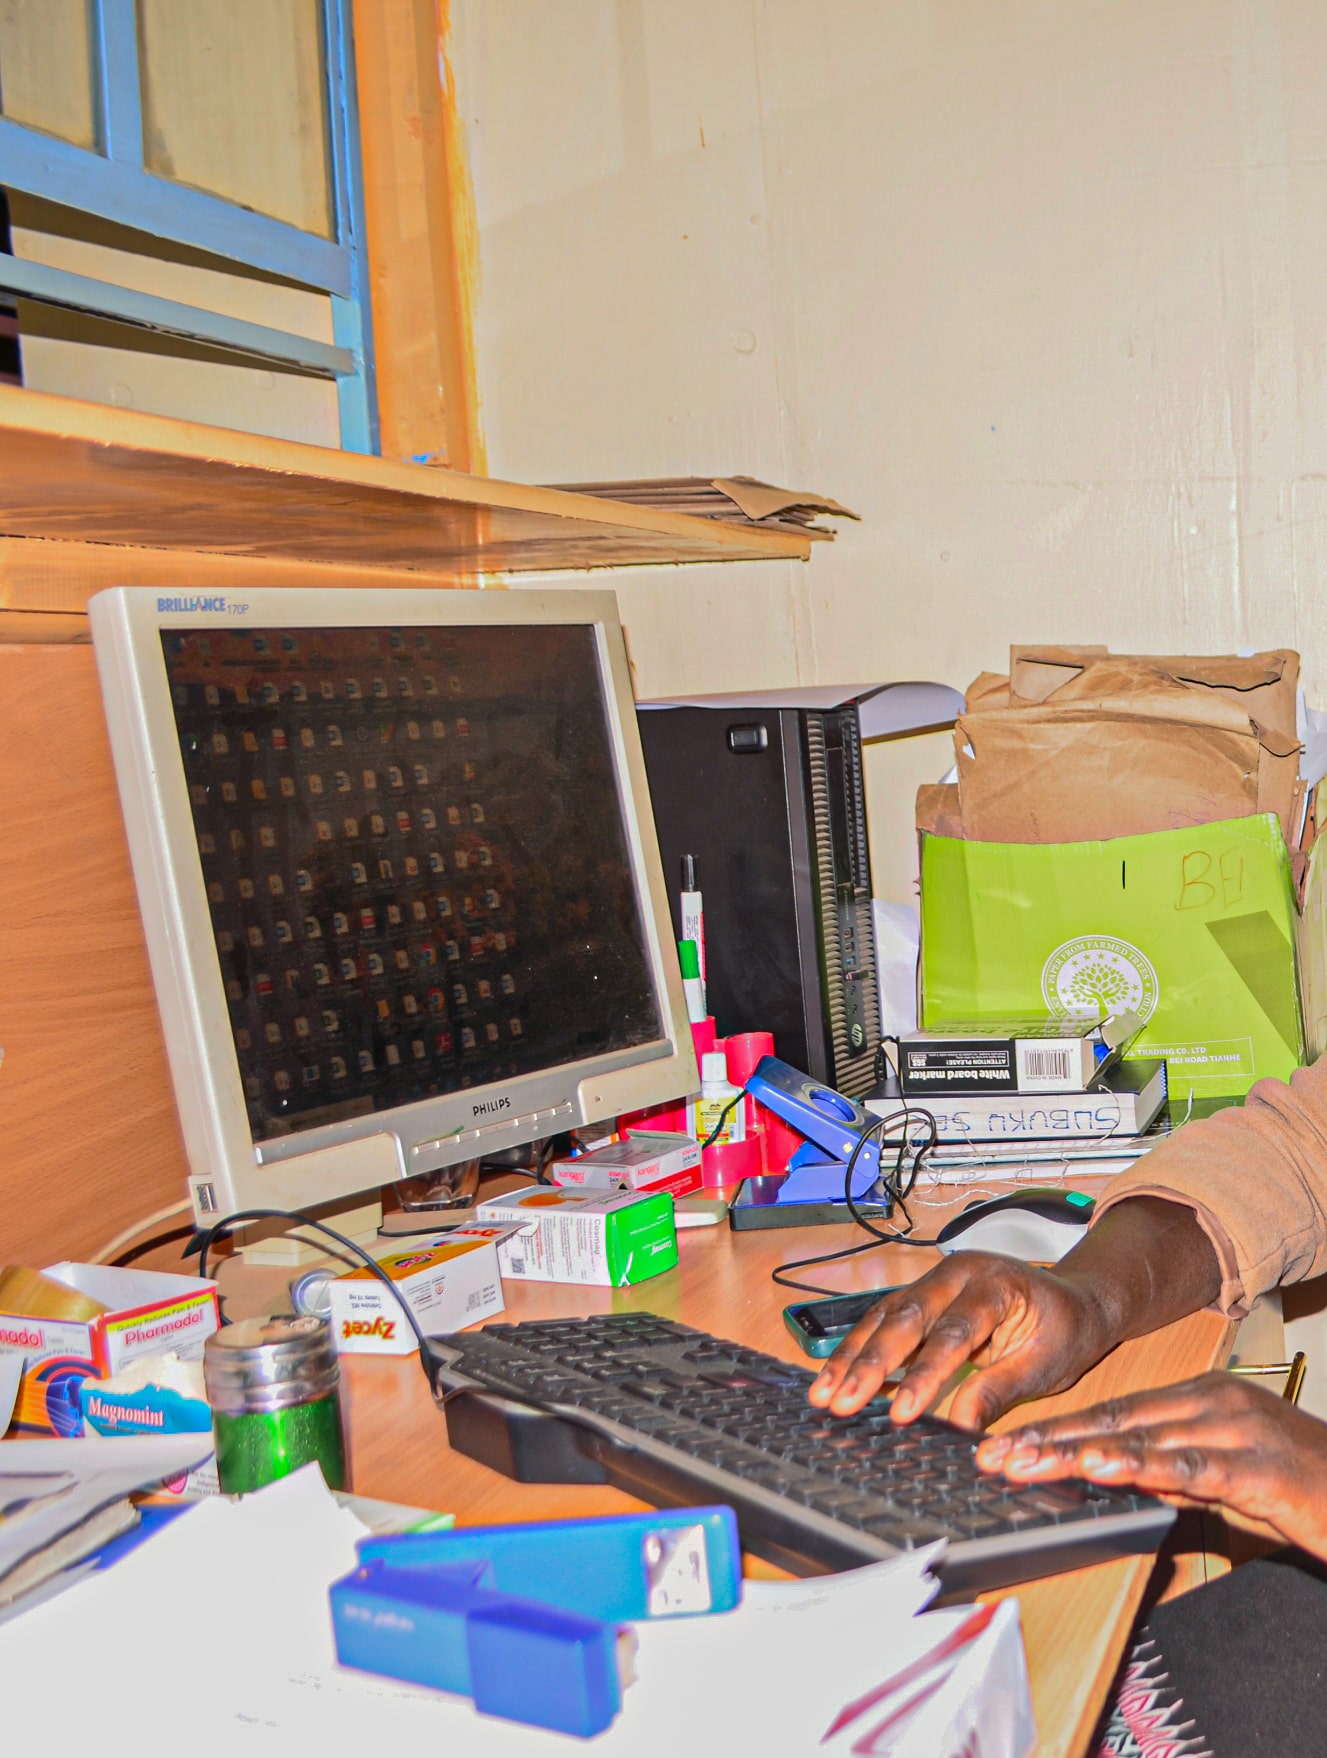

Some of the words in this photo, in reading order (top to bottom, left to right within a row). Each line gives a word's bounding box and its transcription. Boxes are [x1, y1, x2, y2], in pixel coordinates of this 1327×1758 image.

[157, 596, 227, 613] BRILLIANCE
[226, 603, 250, 616] 170P
[1047, 959, 1063, 984] PAPER
[1061, 943, 1086, 960] FROM
[1087, 941, 1129, 955] FARMED
[1128, 955, 1152, 981] TREES
[1138, 1047, 1176, 1056] TRADING
[1191, 1046, 1207, 1055] LTD
[1185, 1055, 1208, 1064] ROAD
[1209, 1054, 1242, 1063] TIANHE
[908, 1070, 946, 1080] marker
[947, 1069, 978, 1080] board
[978, 1069, 1011, 1080] White
[472, 1096, 511, 1117] PHILIPS
[989, 1106, 1120, 1133] SUBUKU
[125, 1309, 204, 1346] Pharmadol
[342, 1316, 397, 1341] Zycet
[88, 1395, 165, 1427] Magnomint
